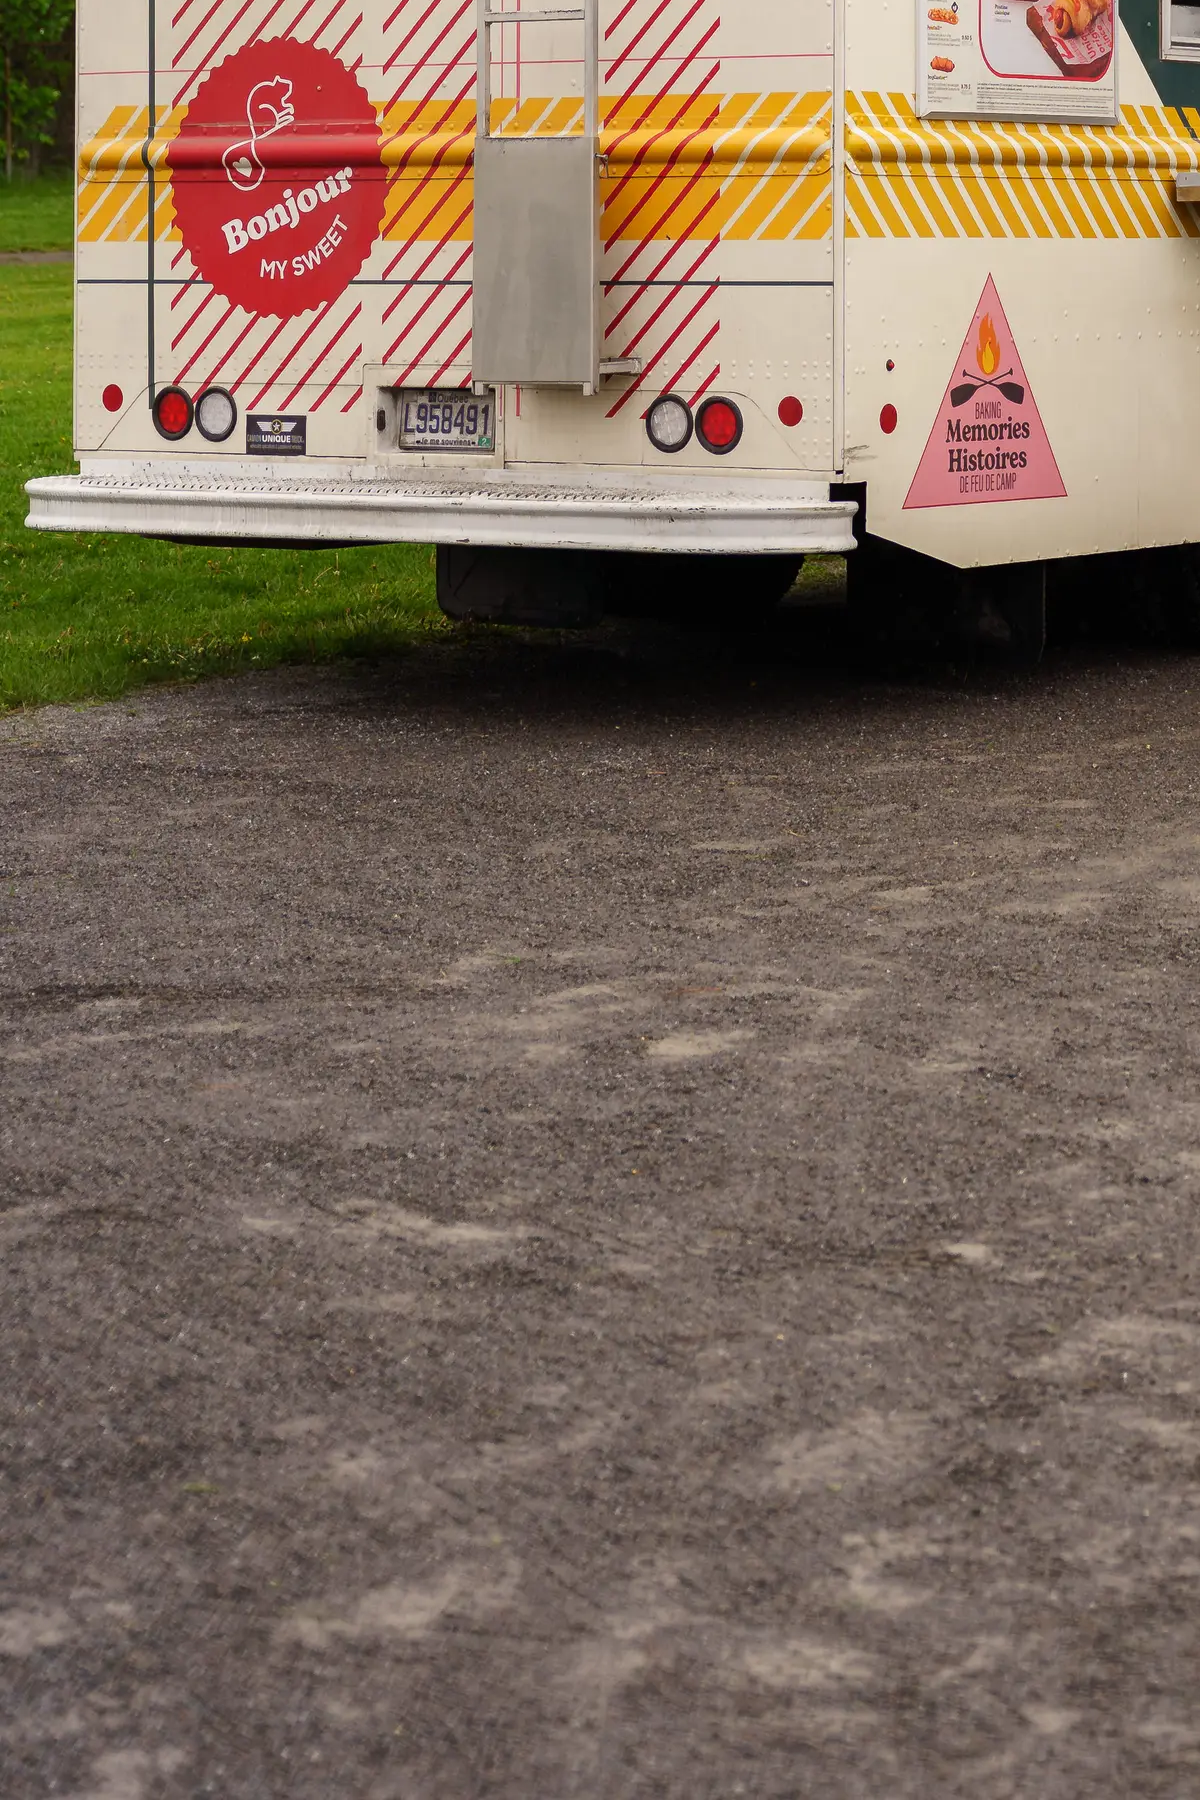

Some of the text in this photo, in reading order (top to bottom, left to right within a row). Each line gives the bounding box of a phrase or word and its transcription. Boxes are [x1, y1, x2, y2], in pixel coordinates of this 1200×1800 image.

[221, 166, 354, 254] Bonjour
[260, 214, 348, 279] MY SWEET
[404, 402, 490, 435] L958491
[975, 401, 1002, 420] BAKING
[261, 434, 291, 443] UNIQUE
[945, 416, 1030, 444] Memories
[947, 446, 1027, 473] Histoires
[959, 472, 1017, 493] DE FEU DE CAMP
